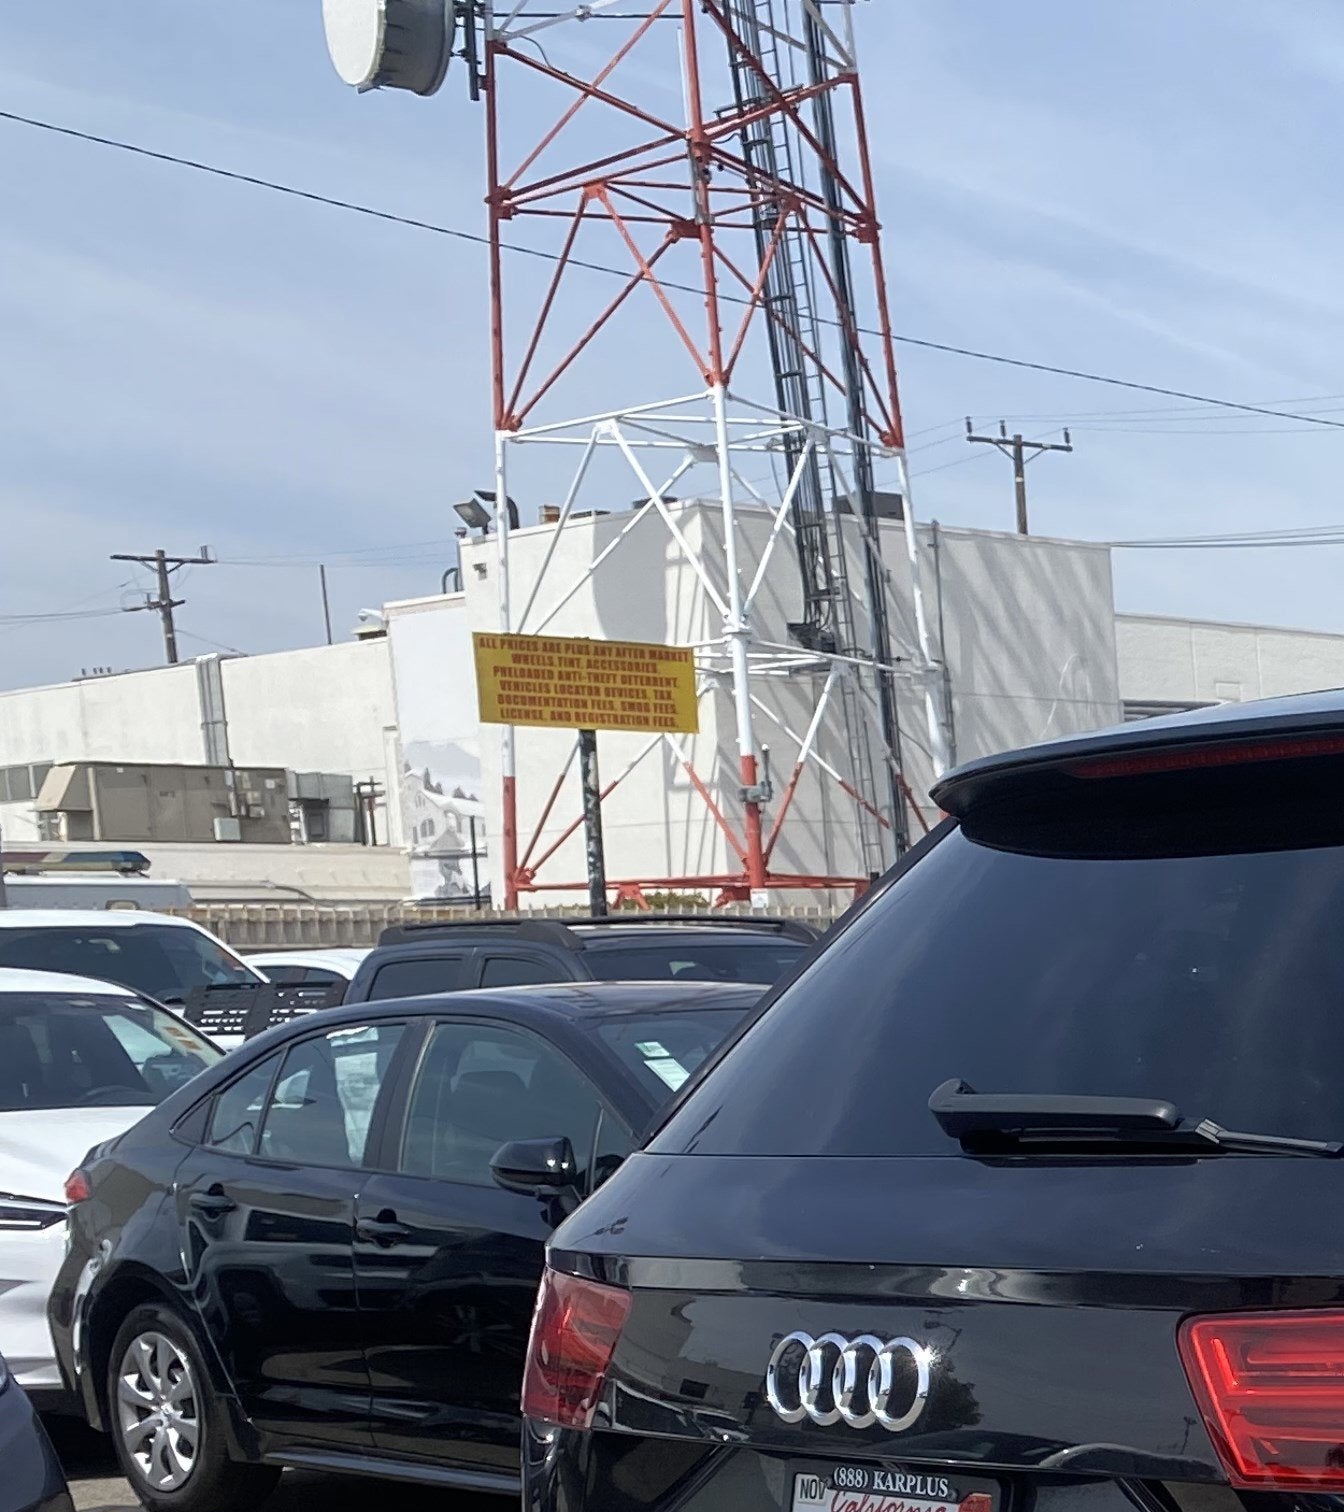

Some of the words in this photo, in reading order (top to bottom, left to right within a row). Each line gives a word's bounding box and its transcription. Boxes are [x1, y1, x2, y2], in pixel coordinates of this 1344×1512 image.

[479, 637, 496, 649] ALL
[500, 638, 539, 652] PRICES
[542, 641, 561, 654] ARE
[564, 643, 589, 656] PLUS
[593, 645, 612, 658] ANY
[615, 647, 645, 660] AFTER
[649, 649, 688, 662] MARKET
[493, 665, 554, 680] PRELOADED
[558, 669, 617, 684] ANTI-THEFT
[499, 679, 550, 694] VEHICLES
[554, 683, 600, 697] LOCATOR
[497, 693, 587, 709] DOCUMENTATION
[621, 701, 650, 713] SMOG
[550, 710, 571, 722] AND
[575, 712, 650, 726] REGISTRATION
[800, 1478, 827, 1500] NOV
[833, 1467, 869, 1489] (888)
[873, 1471, 949, 1498] KARPLUS
